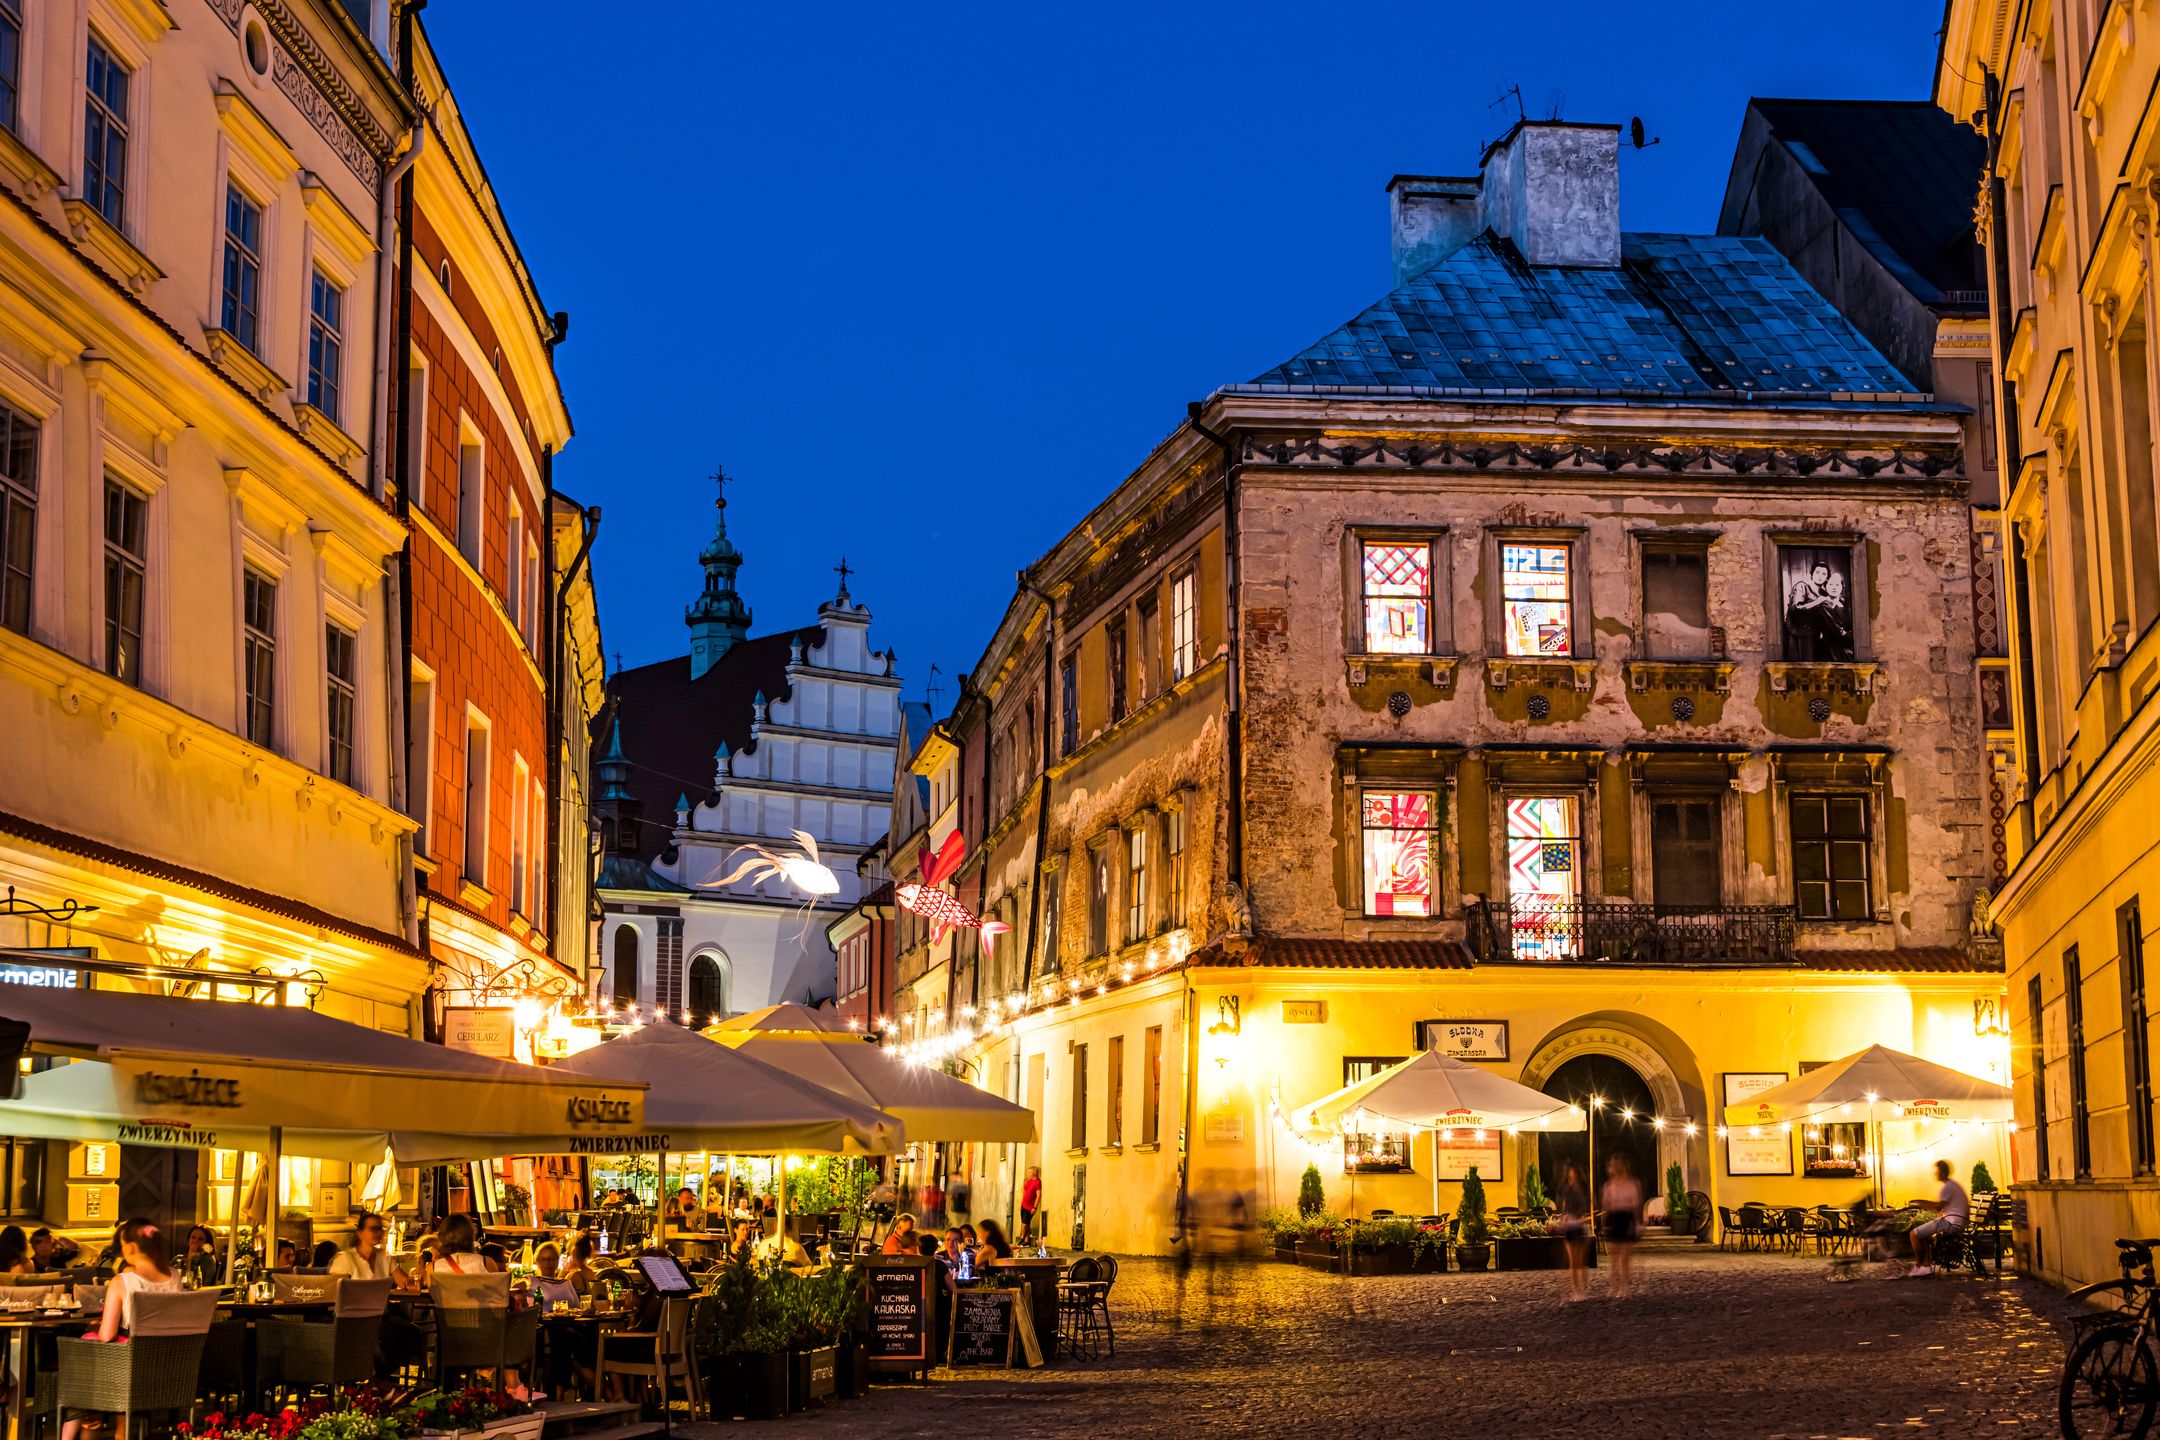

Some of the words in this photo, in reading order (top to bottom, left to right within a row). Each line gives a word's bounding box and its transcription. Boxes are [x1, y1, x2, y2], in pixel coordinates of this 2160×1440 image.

[456, 1031, 500, 1042] CEBULARZ
[1903, 1106, 1950, 1117] ZWIERZYNIEC
[1434, 1115, 1483, 1126] ZWIERZYNIEC
[117, 1123, 217, 1147] ZWIERZYNIEC
[568, 1134, 671, 1154] ZWIERZYNIEC
[876, 1273, 915, 1281] armenia
[874, 1304, 916, 1314] KAUKASKA
